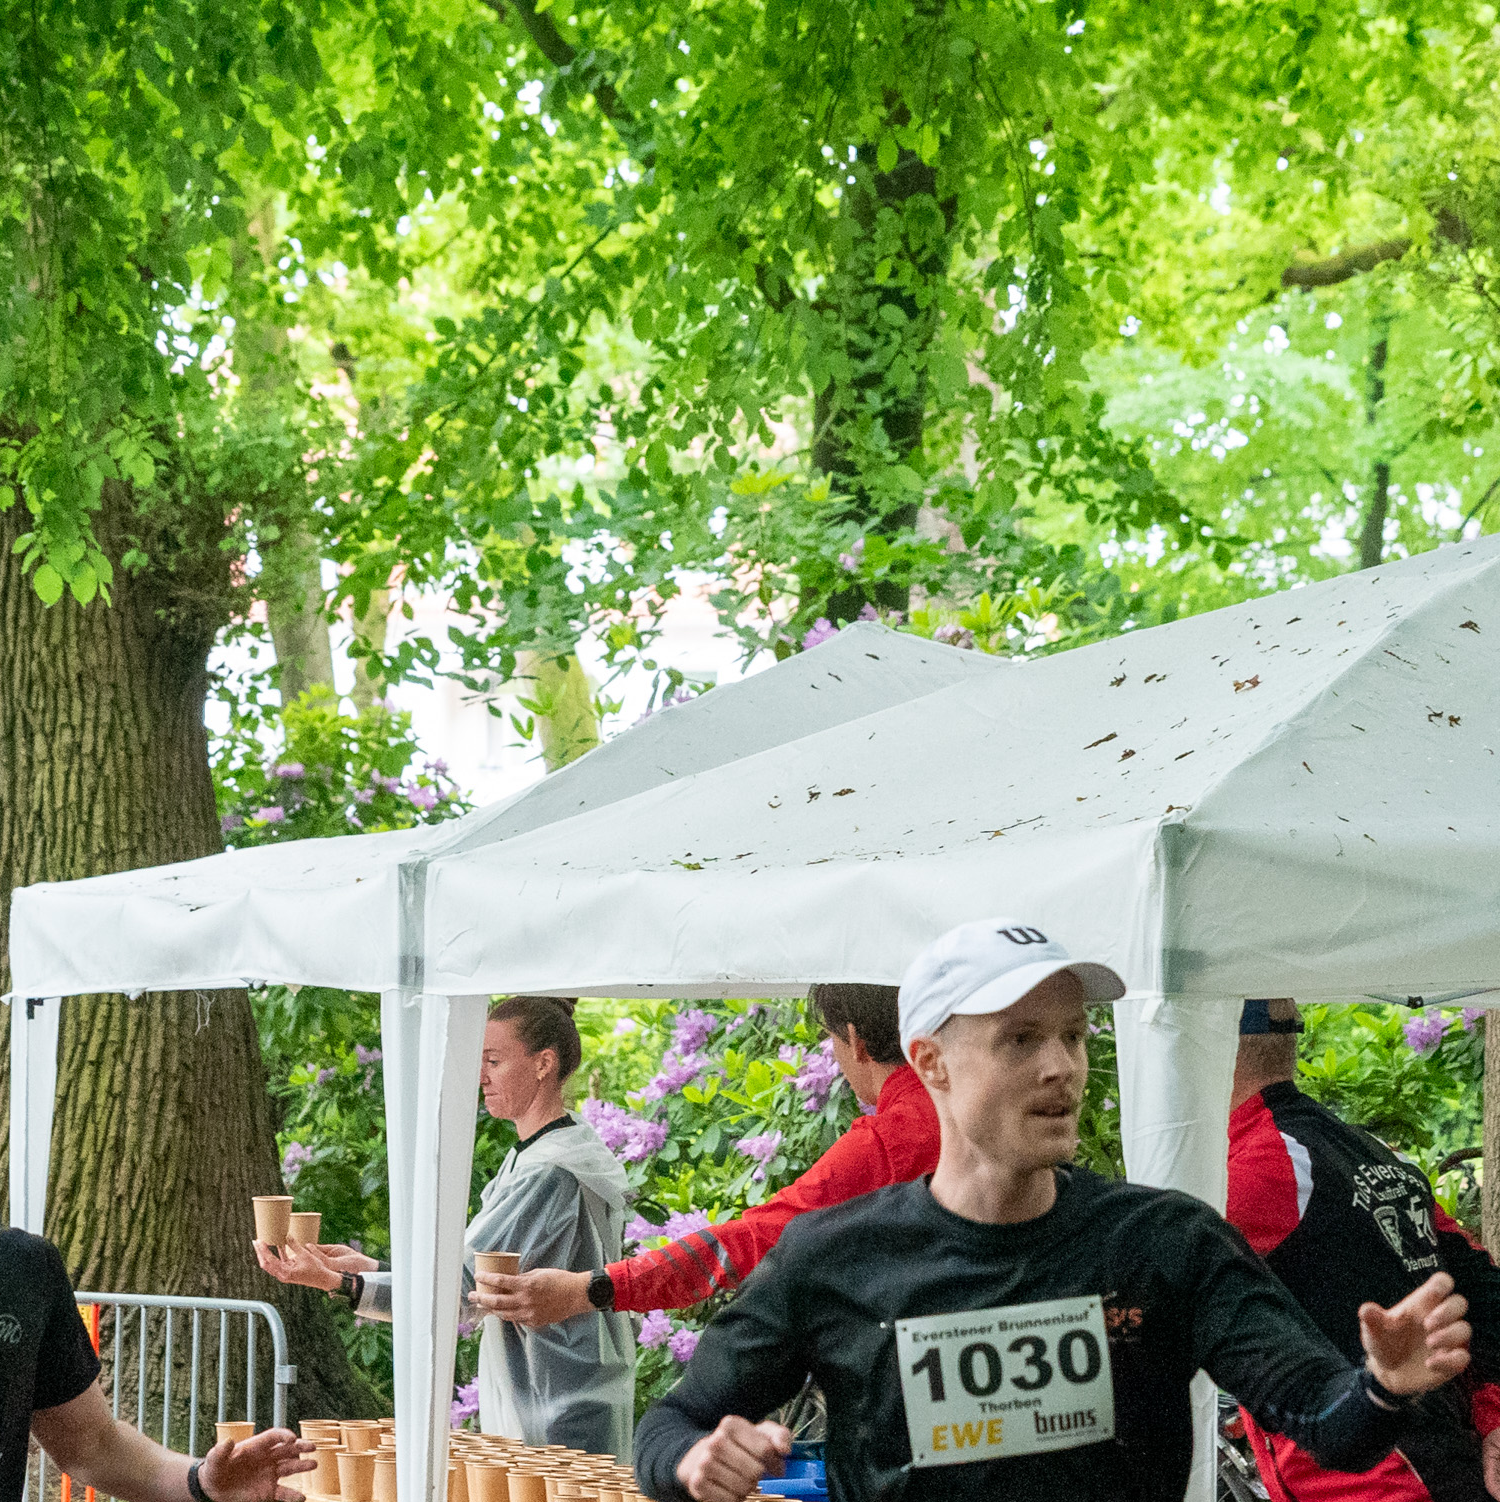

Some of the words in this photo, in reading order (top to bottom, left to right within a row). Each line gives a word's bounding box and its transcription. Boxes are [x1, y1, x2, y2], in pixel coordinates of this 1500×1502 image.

[911, 1324, 993, 1344] Everstener
[998, 1310, 1090, 1332] Brunnenlauf
[911, 1328, 1102, 1403] 1030
[979, 1397, 1042, 1414] Thorben
[932, 1418, 1003, 1452] EWE
[1034, 1407, 1097, 1435] bruns
